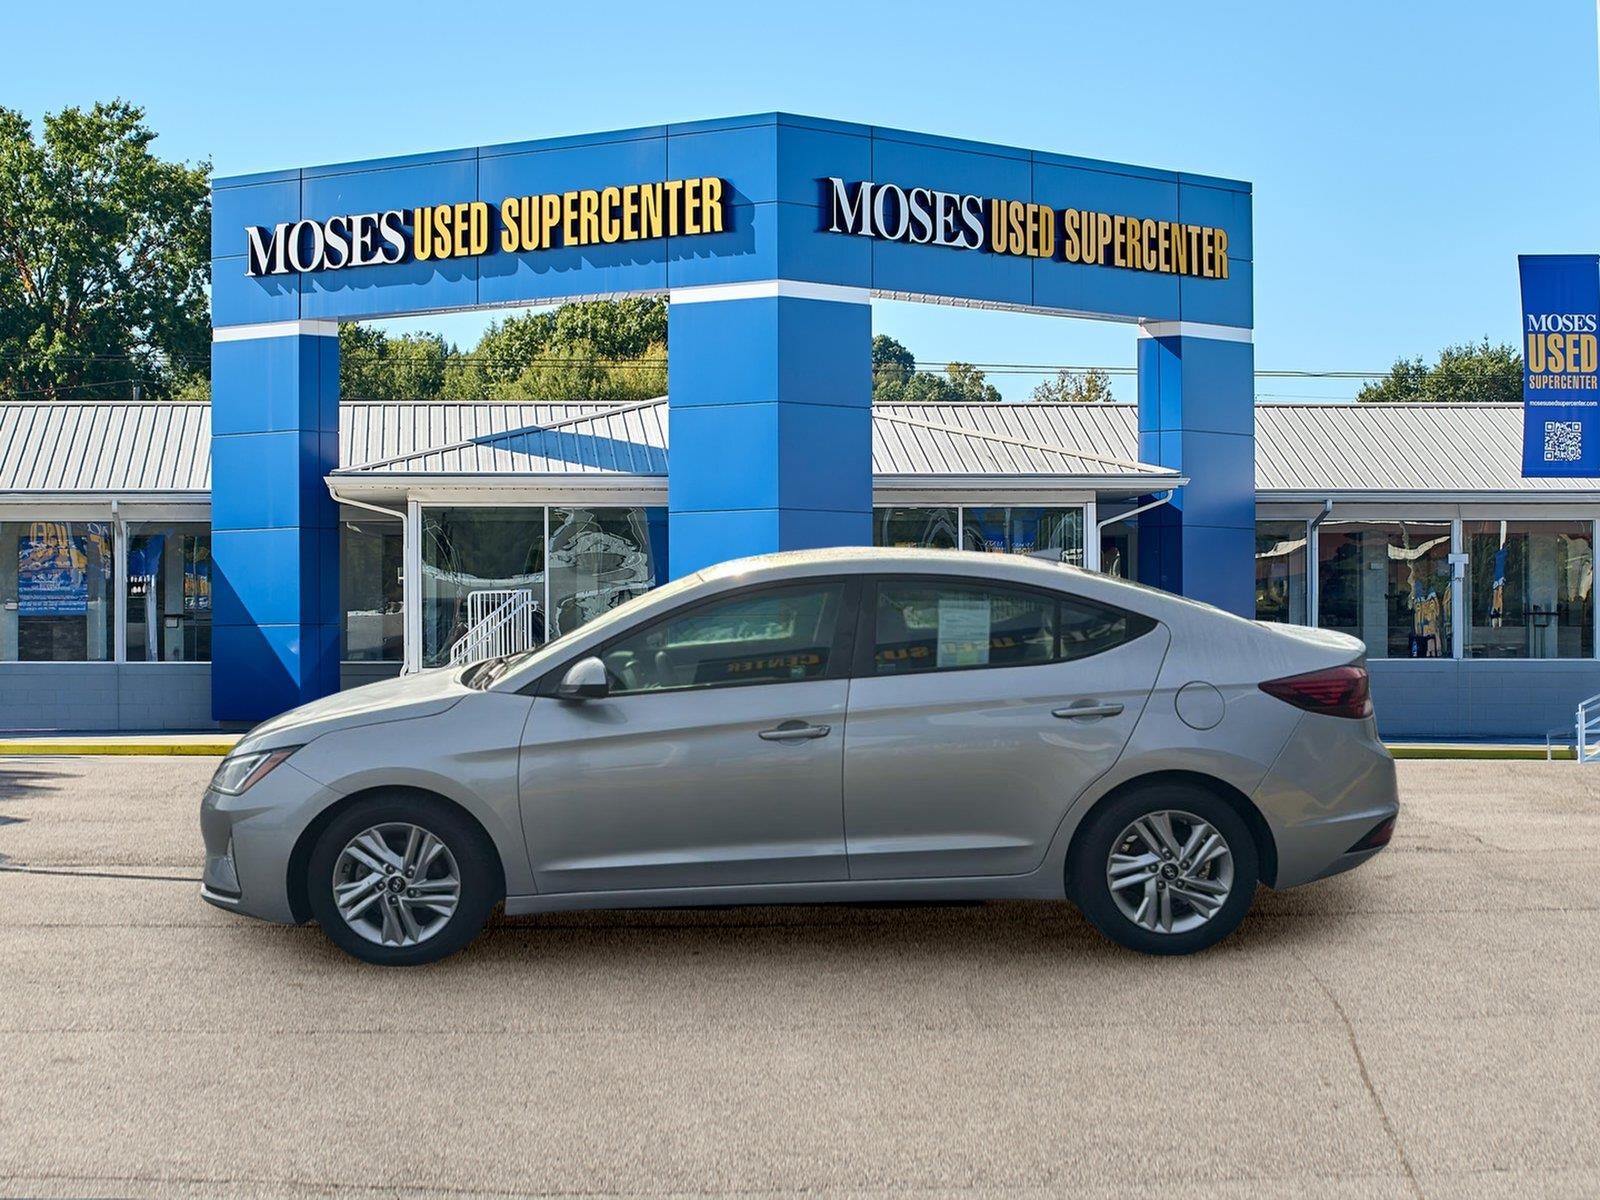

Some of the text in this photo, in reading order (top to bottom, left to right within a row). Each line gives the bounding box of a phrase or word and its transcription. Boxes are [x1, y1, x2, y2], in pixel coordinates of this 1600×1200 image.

[244, 176, 723, 277] MOSES USED SUPERCENTER
[829, 177, 1229, 279] MOSES USED SUPERCENTER
[1527, 313, 1597, 332] MOSES
[1528, 333, 1598, 373] USED
[1529, 375, 1598, 389] SUPERCENTER
